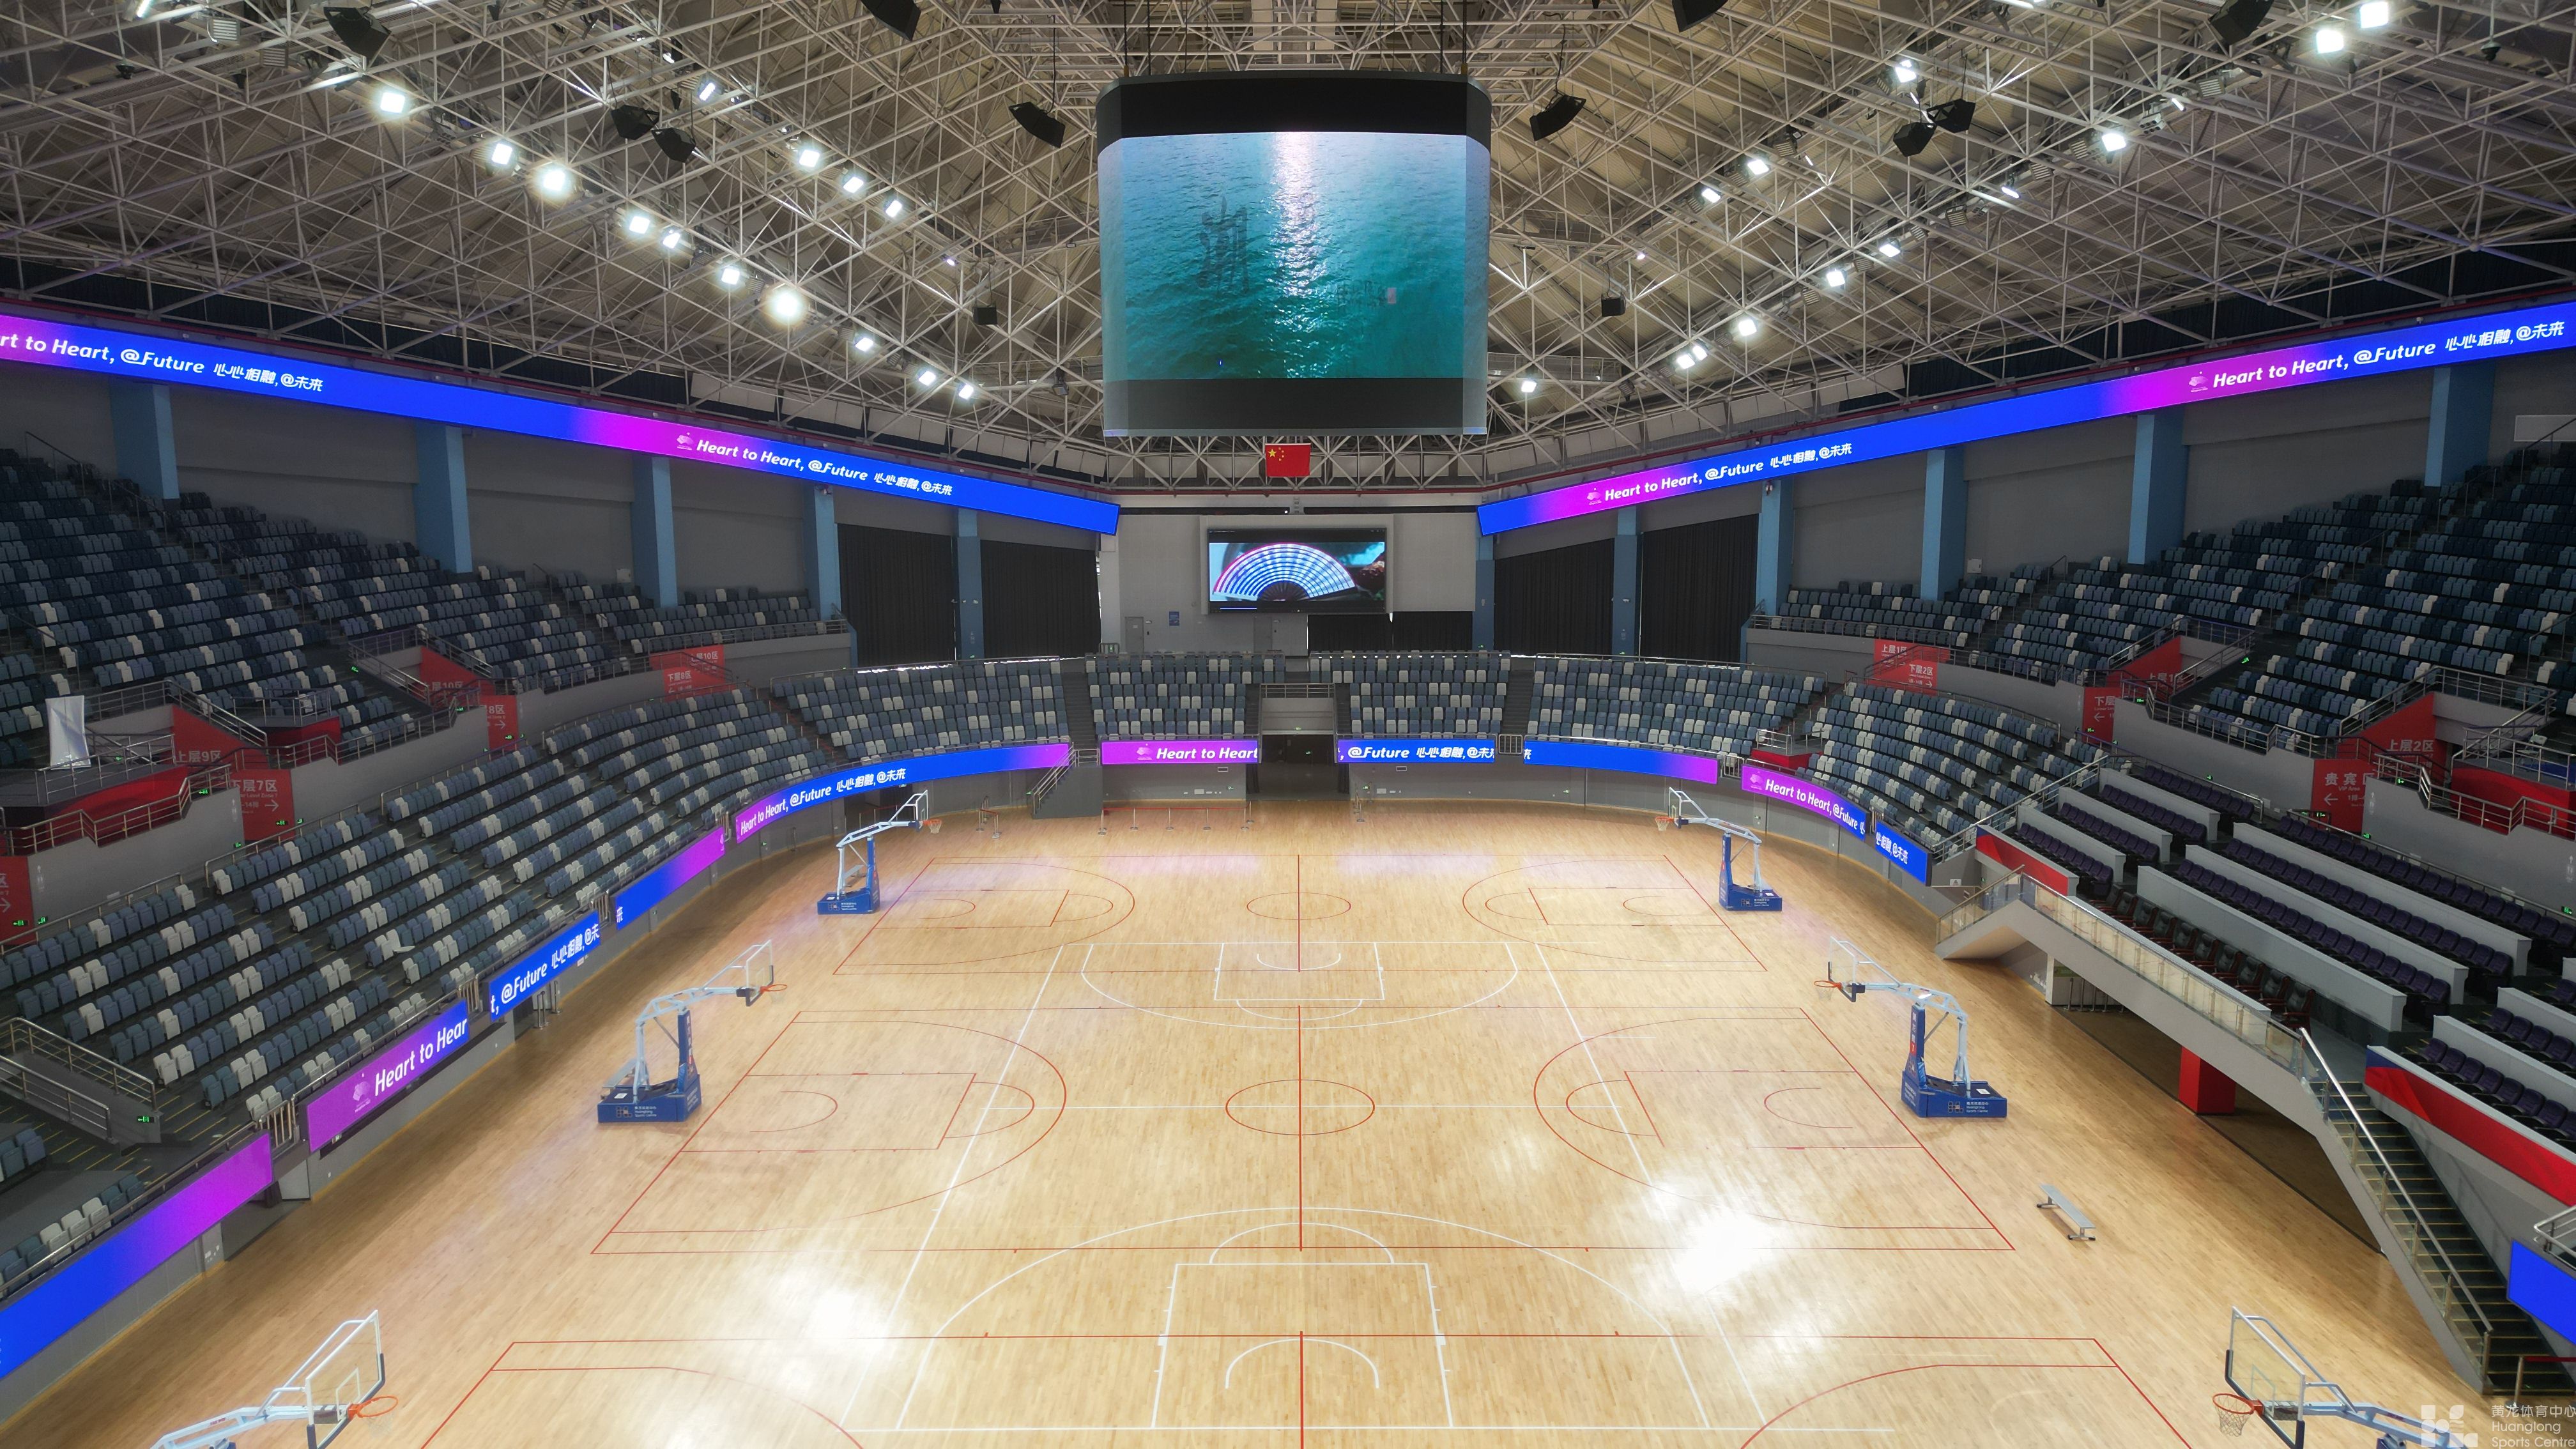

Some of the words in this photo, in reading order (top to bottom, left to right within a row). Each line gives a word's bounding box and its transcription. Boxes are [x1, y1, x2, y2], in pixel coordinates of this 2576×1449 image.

[26, 335, 47, 351] to
[52, 339, 115, 364] Heart,
[120, 349, 205, 373] @Future
[2213, 367, 2264, 388] Heart
[2269, 365, 2287, 379] to
[2291, 355, 2349, 376] Heart,
[2354, 343, 2436, 365] @Future
[696, 440, 739, 457] Heart
[742, 448, 758, 461] to
[760, 451, 804, 471] Heart,
[808, 459, 868, 480] @Future
[1605, 484, 1641, 501] Heart
[1644, 482, 1659, 493] to
[1661, 472, 1703, 490] Heart,
[1705, 461, 1763, 480] @Future
[1156, 747, 1197, 760] Heart
[1201, 747, 1216, 759] to
[1218, 747, 1258, 759] Heart
[1347, 746, 1410, 759] @Future
[2386, 739, 2434, 752] 上层2区
[740, 813, 757, 836] Heart
[758, 811, 764, 824] to
[765, 799, 788, 820] Heart,
[790, 786, 832, 807] @Future
[1765, 779, 1795, 799] Heart
[1797, 788, 1806, 802] to
[1807, 792, 1832, 816] Heart,
[1833, 803, 1858, 830] @Future
[501, 963, 548, 1004] @Future
[374, 1051, 415, 1097] Heart
[420, 1043, 434, 1064] to
[436, 1018, 468, 1053] Hear
